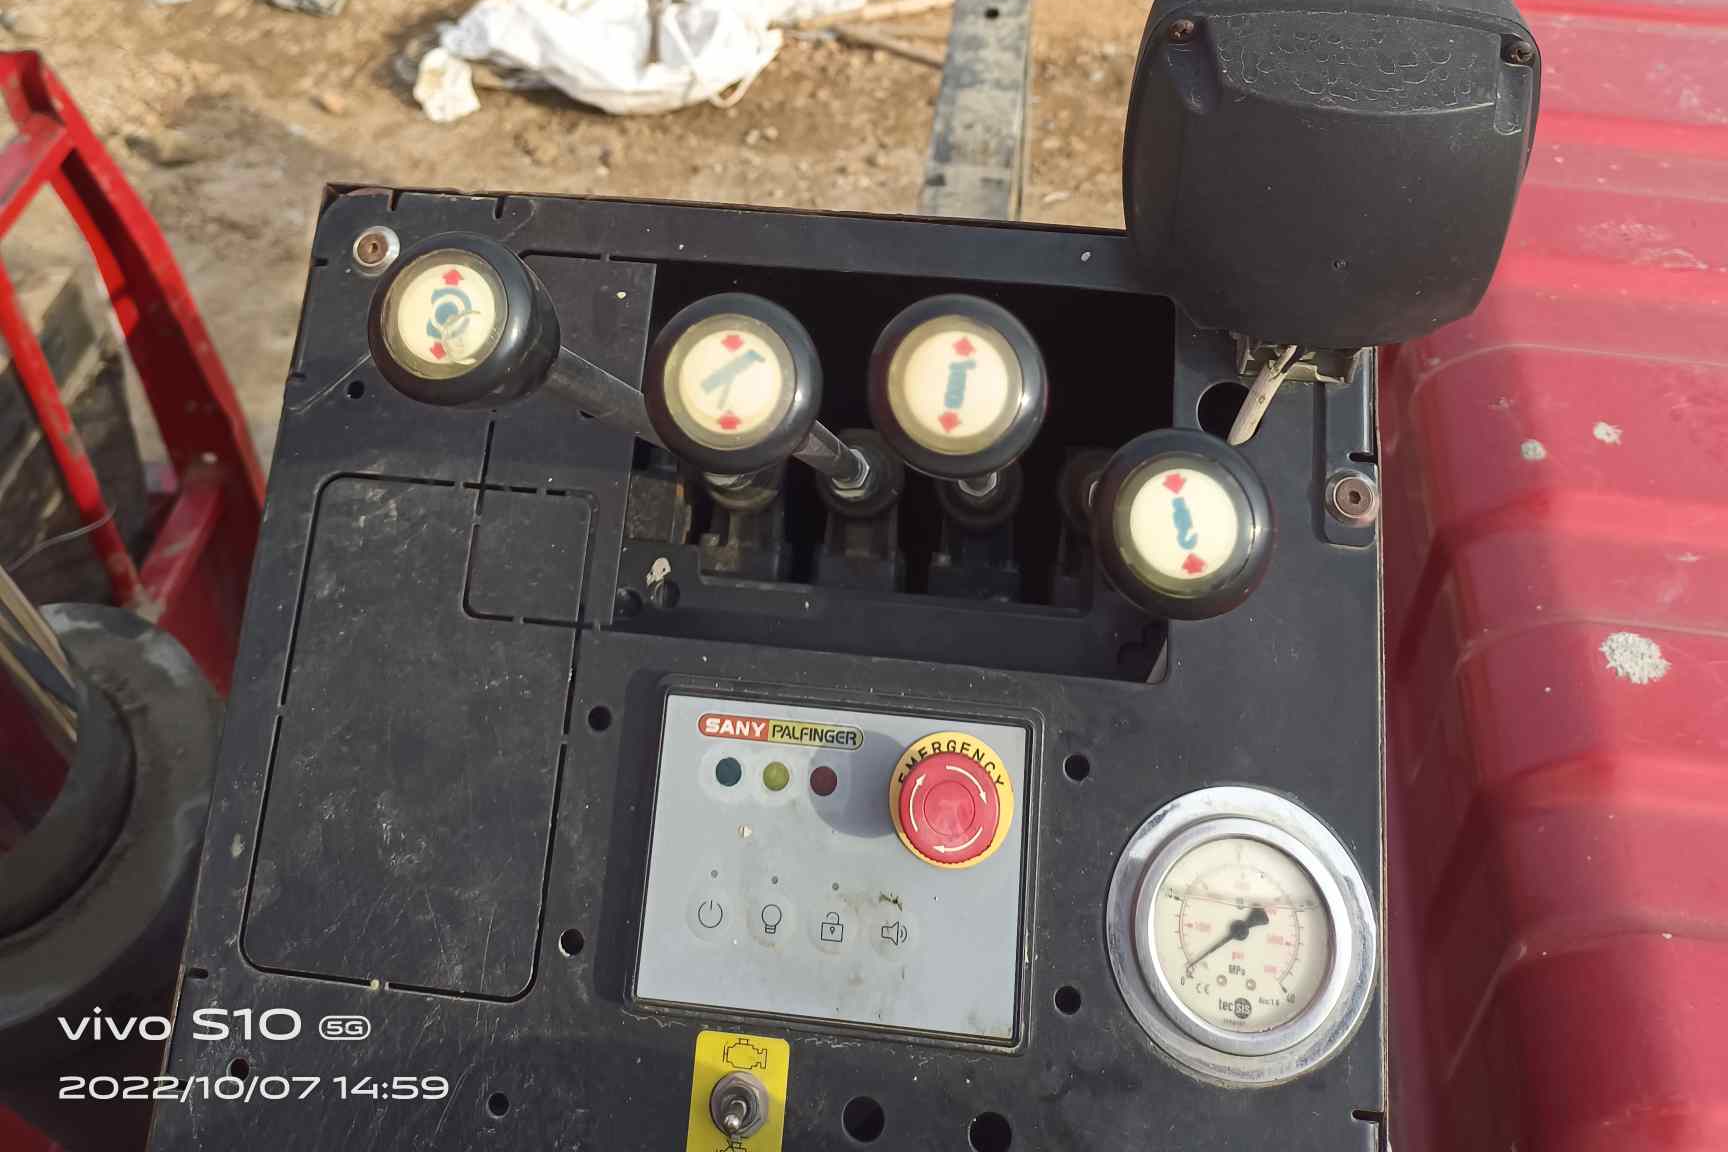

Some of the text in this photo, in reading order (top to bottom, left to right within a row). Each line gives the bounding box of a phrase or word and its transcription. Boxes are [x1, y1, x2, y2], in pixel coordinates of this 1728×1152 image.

[705, 718, 858, 746] SANY PALFINGER
[898, 739, 1005, 786] EMERGENCY
